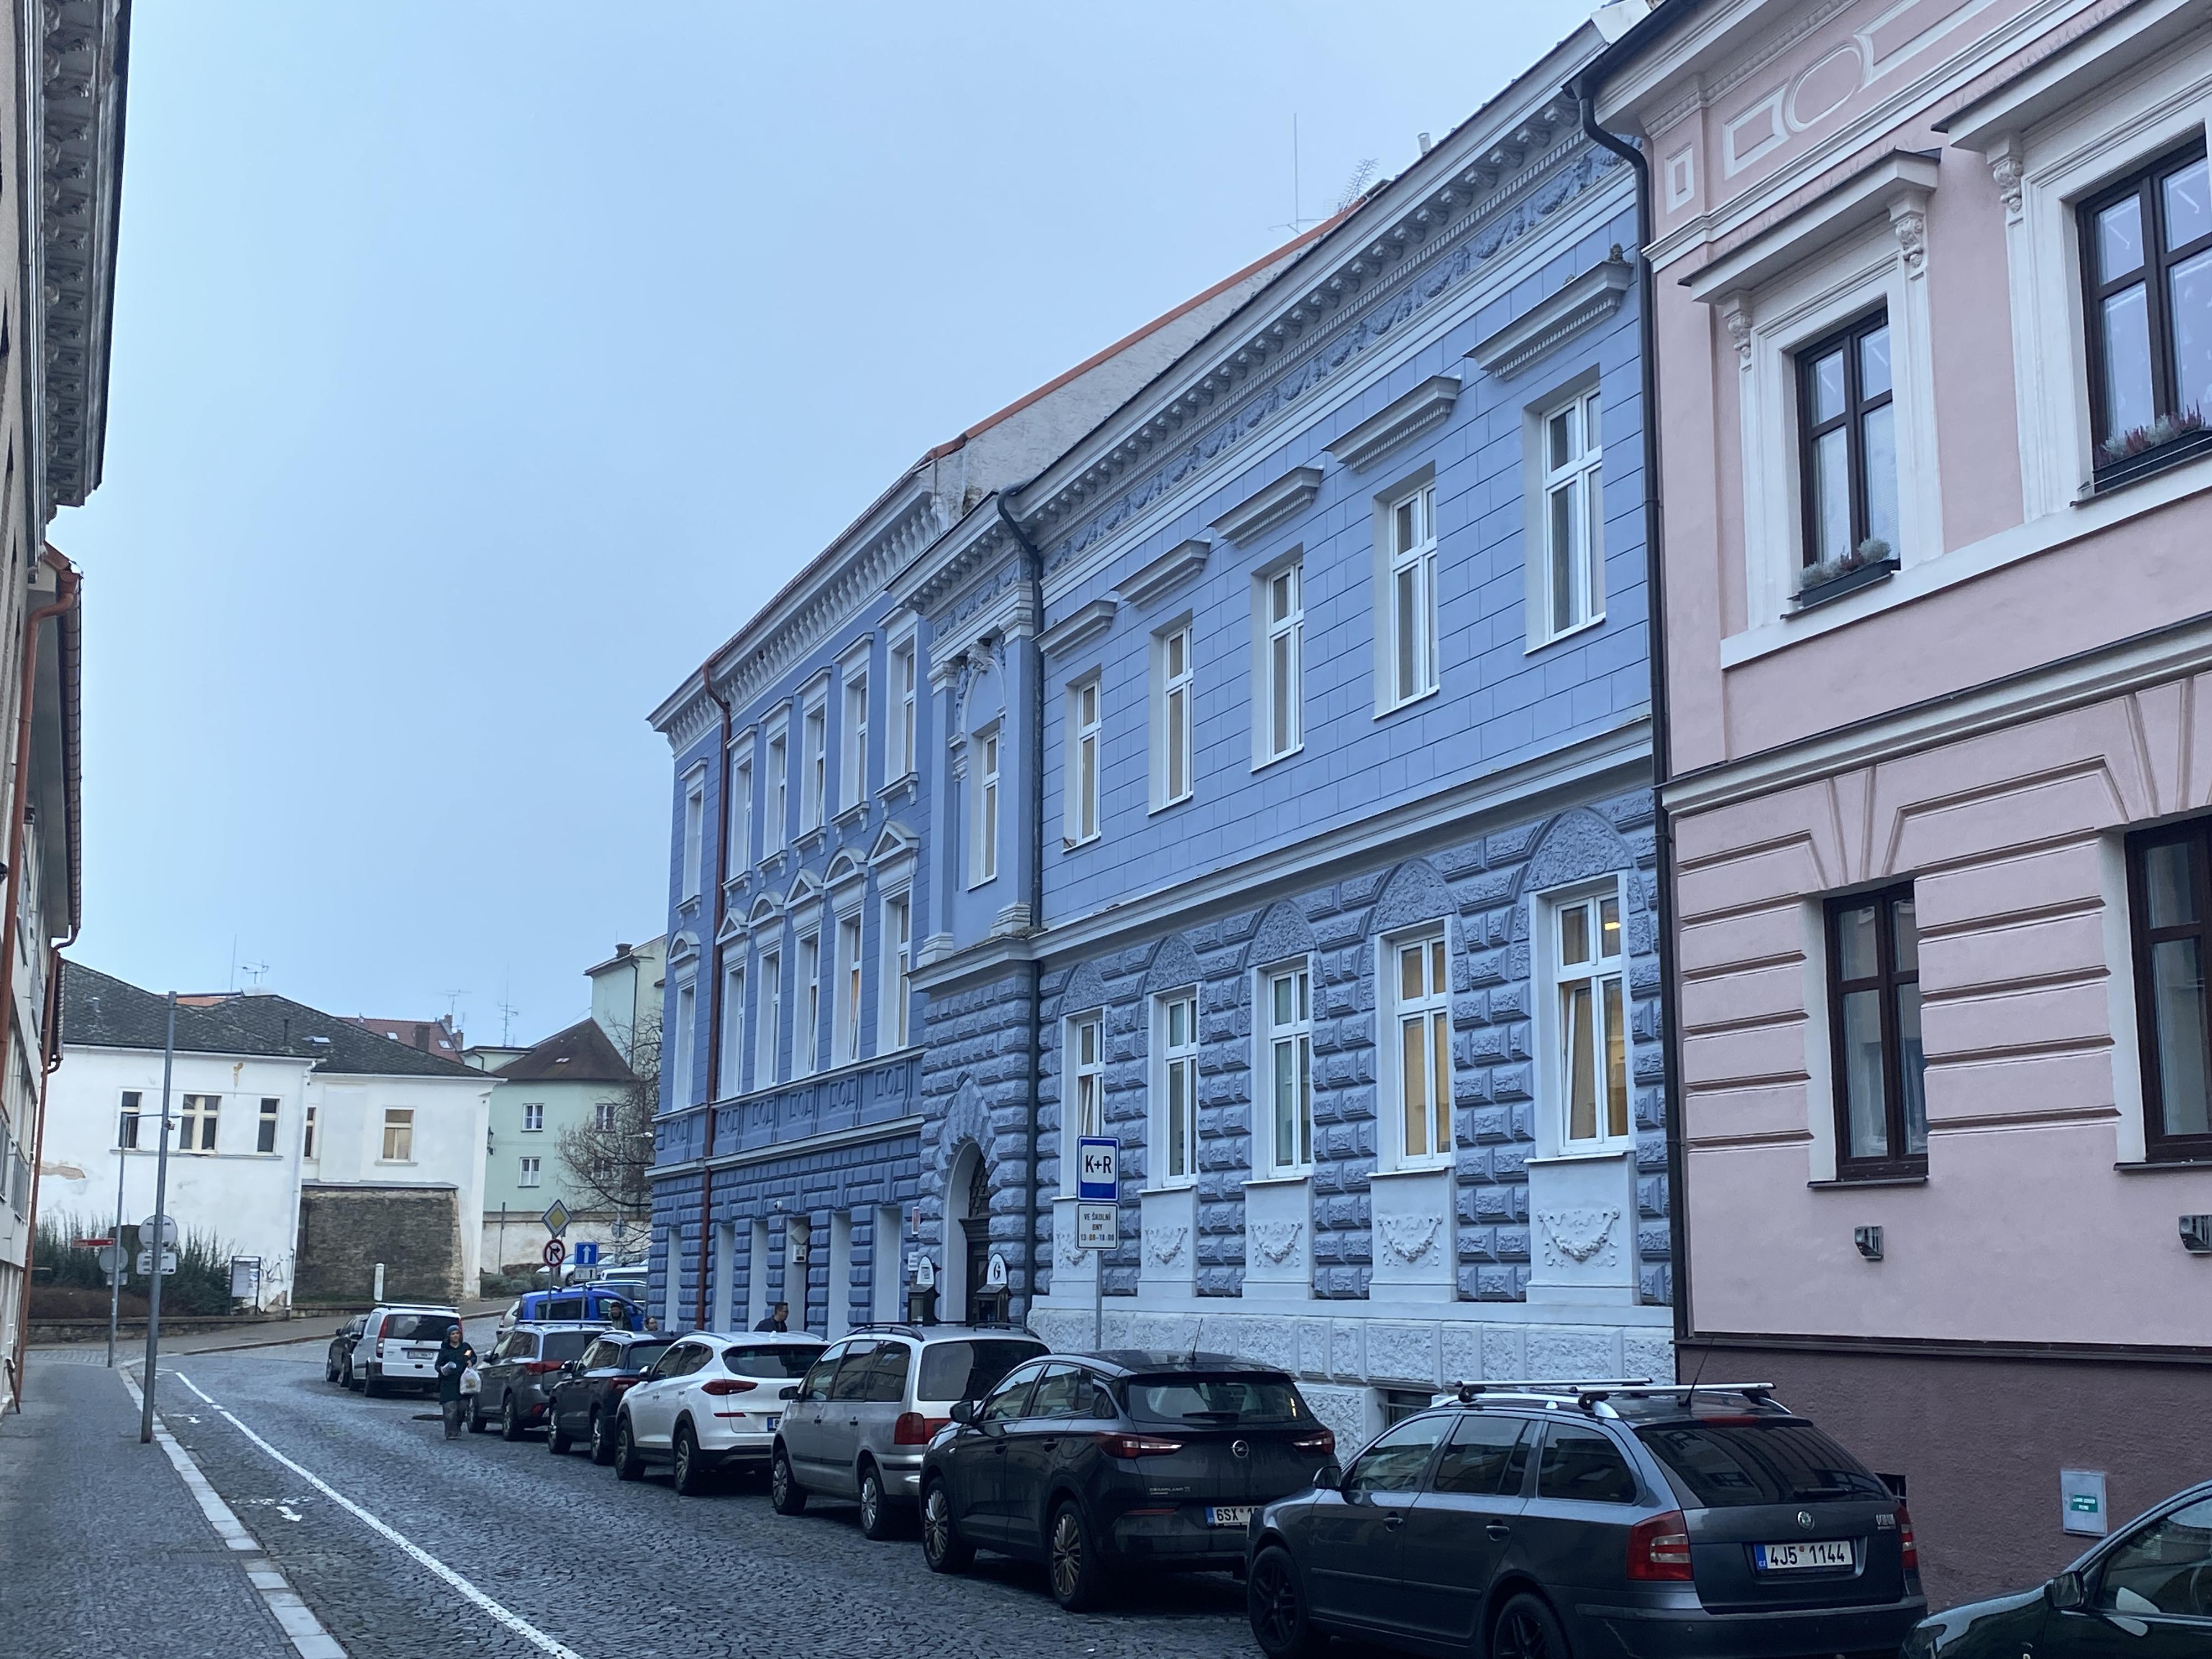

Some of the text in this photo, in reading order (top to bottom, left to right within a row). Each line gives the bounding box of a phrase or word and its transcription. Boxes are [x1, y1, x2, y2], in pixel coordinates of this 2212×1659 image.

[1085, 1155, 1112, 1173] K+R
[1217, 1508, 1239, 1521] 6SX
[1771, 1543, 1845, 1566] 4J5 1144
